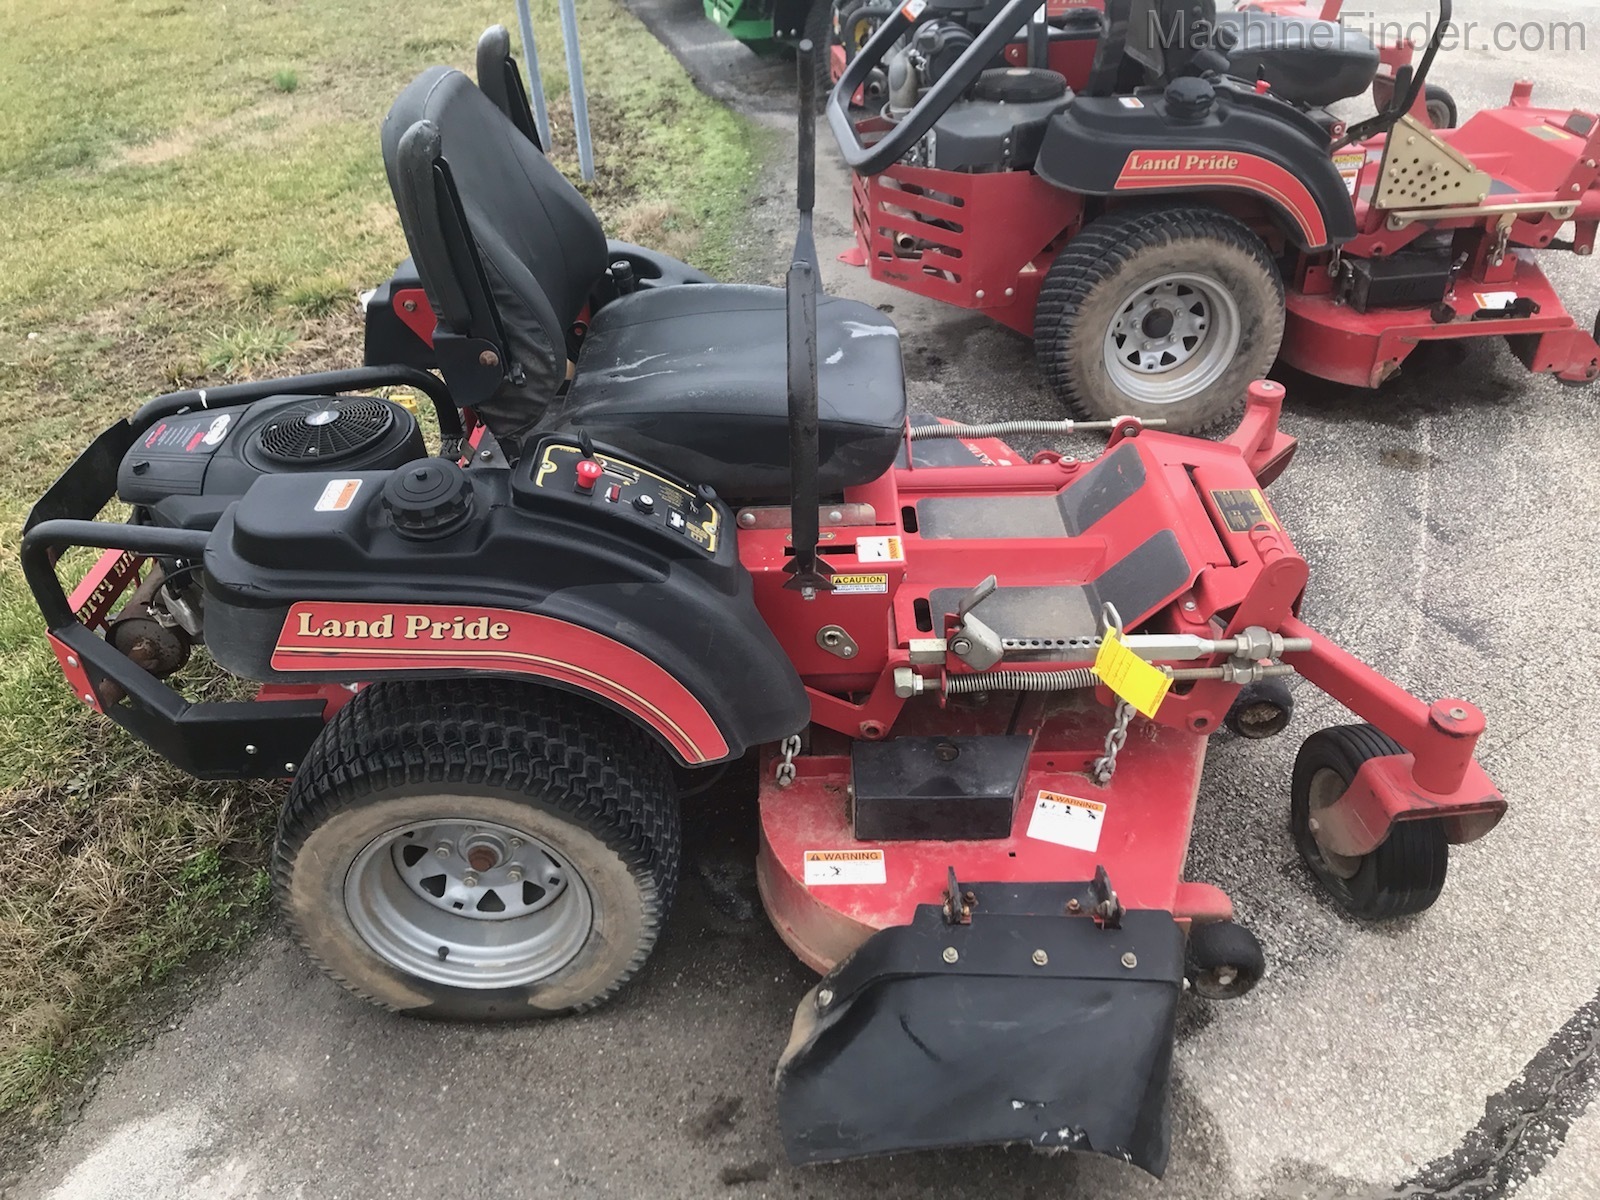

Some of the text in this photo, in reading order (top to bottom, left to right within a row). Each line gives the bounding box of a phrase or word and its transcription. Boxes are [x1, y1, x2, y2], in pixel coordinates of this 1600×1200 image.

[1130, 154, 1238, 170] Land Pride
[843, 576, 882, 584] CAUTION
[296, 612, 511, 641] Land Pride
[1056, 796, 1099, 810] WARNING
[824, 852, 879, 861] WARNING
